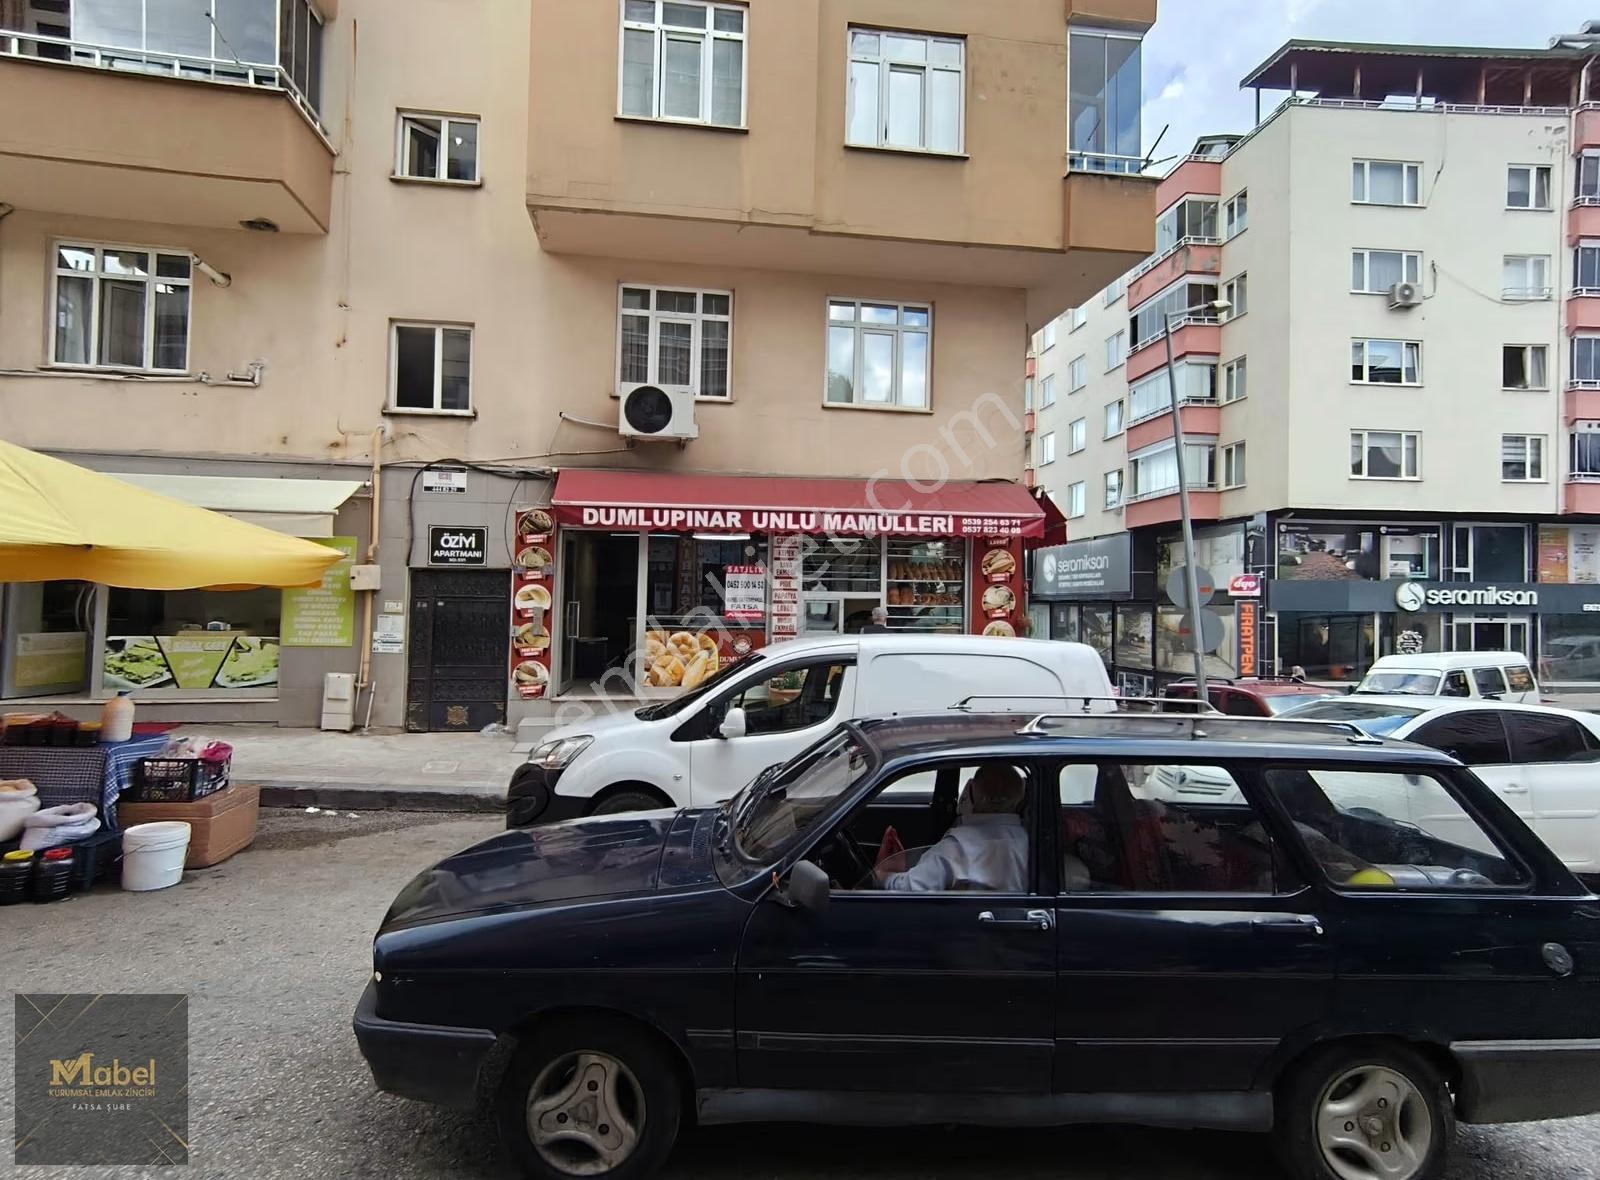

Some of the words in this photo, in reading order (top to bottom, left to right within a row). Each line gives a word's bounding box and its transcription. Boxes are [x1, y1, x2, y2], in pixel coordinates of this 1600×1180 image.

[583, 507, 742, 528] DUMLUPINAR
[752, 511, 817, 530] UNLU
[823, 511, 955, 533] MAMÜLLERİ
[983, 518, 999, 526] 254
[440, 532, 476, 549] ÖZİYİ
[433, 550, 482, 558] APARTMANI
[1057, 554, 1109, 573] seramiksan
[1426, 586, 1538, 605] seramiksan
[1240, 603, 1254, 674] FIRATPEN
